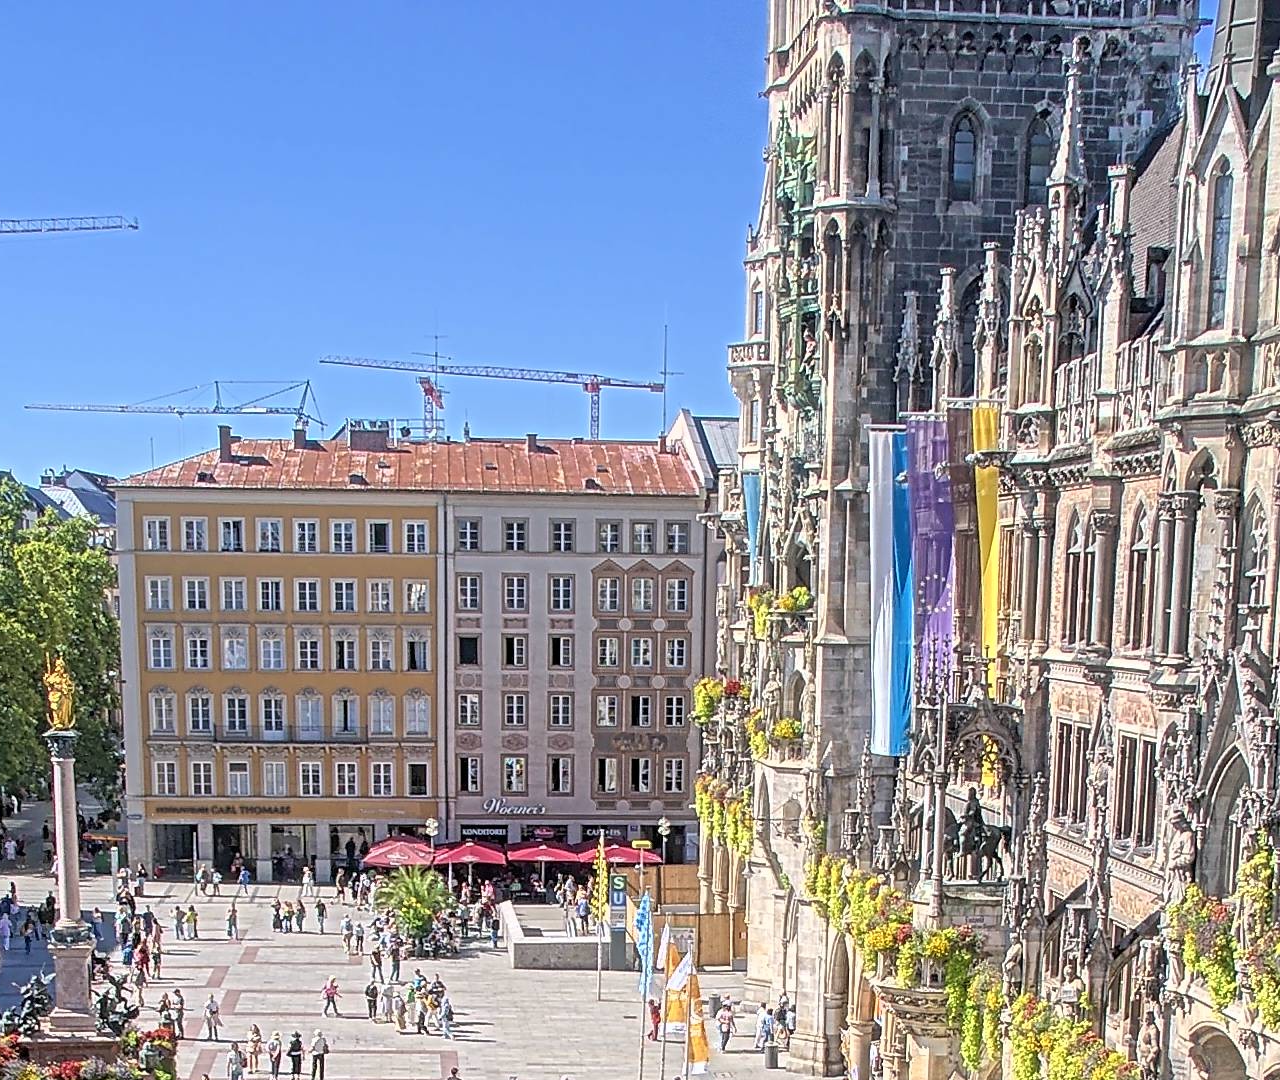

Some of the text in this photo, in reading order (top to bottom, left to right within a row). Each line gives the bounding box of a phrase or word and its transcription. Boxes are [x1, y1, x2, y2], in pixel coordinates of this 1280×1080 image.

[462, 828, 506, 836] KONDITOREI
[613, 876, 625, 889] S
[613, 893, 624, 905] U
